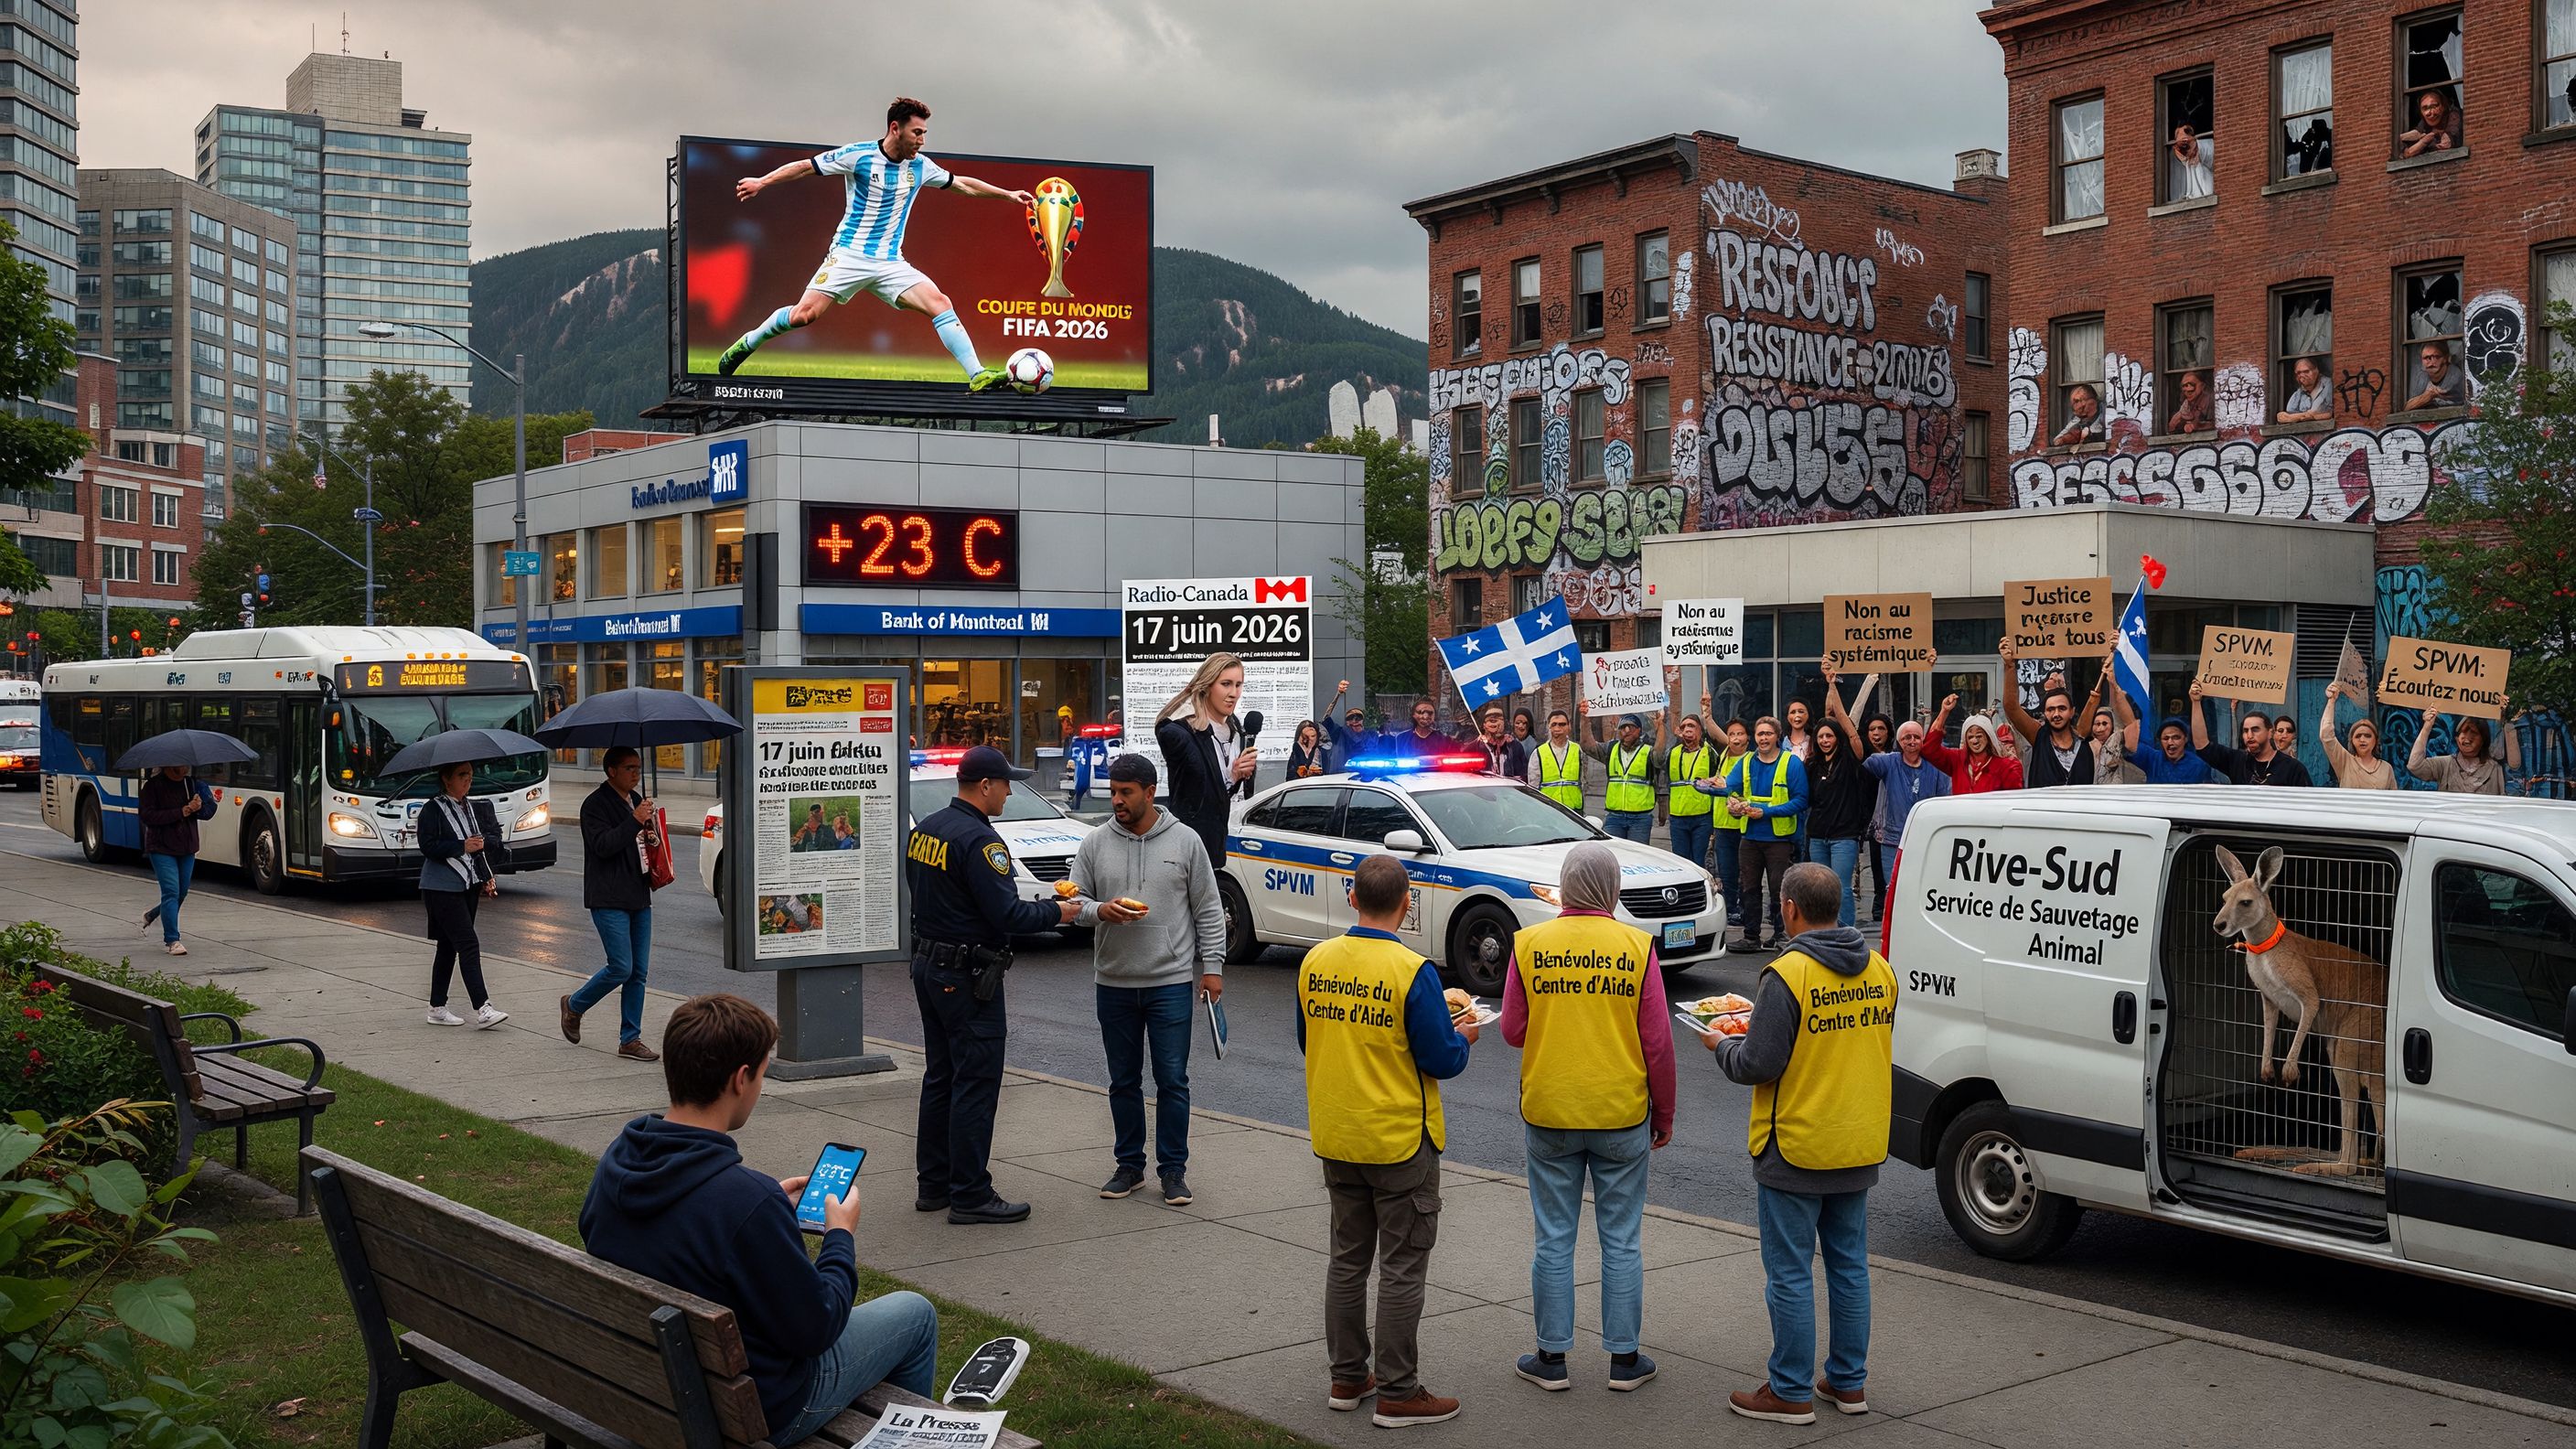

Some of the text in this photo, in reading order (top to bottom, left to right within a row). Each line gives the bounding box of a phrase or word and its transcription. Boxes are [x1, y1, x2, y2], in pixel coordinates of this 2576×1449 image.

[977, 298, 1036, 316] COUPE
[1040, 302, 1065, 317] DU
[1003, 317, 1110, 340] FIFA 2026
[818, 514, 1002, 577] +23 C
[1127, 584, 1249, 603] Radio-Canada
[2021, 585, 2091, 606] Justice
[881, 611, 924, 629] Bank
[928, 612, 945, 629] of
[1678, 603, 1725, 619] Non au
[1844, 599, 1911, 619] Non au
[1132, 614, 1302, 652] 17 juin 2026
[1844, 623, 1913, 640] racisme
[2065, 628, 2107, 646] tous
[1830, 645, 1927, 669] systémique
[2413, 646, 2485, 677] SPVM:
[759, 741, 784, 761] 17
[788, 740, 825, 764] juin
[1948, 837, 2122, 896] Rive-Sud
[1264, 867, 1315, 896] SPVM
[1925, 888, 2140, 939] Service de Sauvetage
[1533, 949, 1636, 972] Bénévoles du
[2027, 932, 2104, 966] Animal
[1308, 972, 1392, 1003] Bénévoles du
[1532, 974, 1636, 997] Centre d'Aide
[1349, 1004, 1394, 1028] d'Aide
[1808, 1012, 1856, 1035] Centre
[888, 1412, 915, 1428] La
